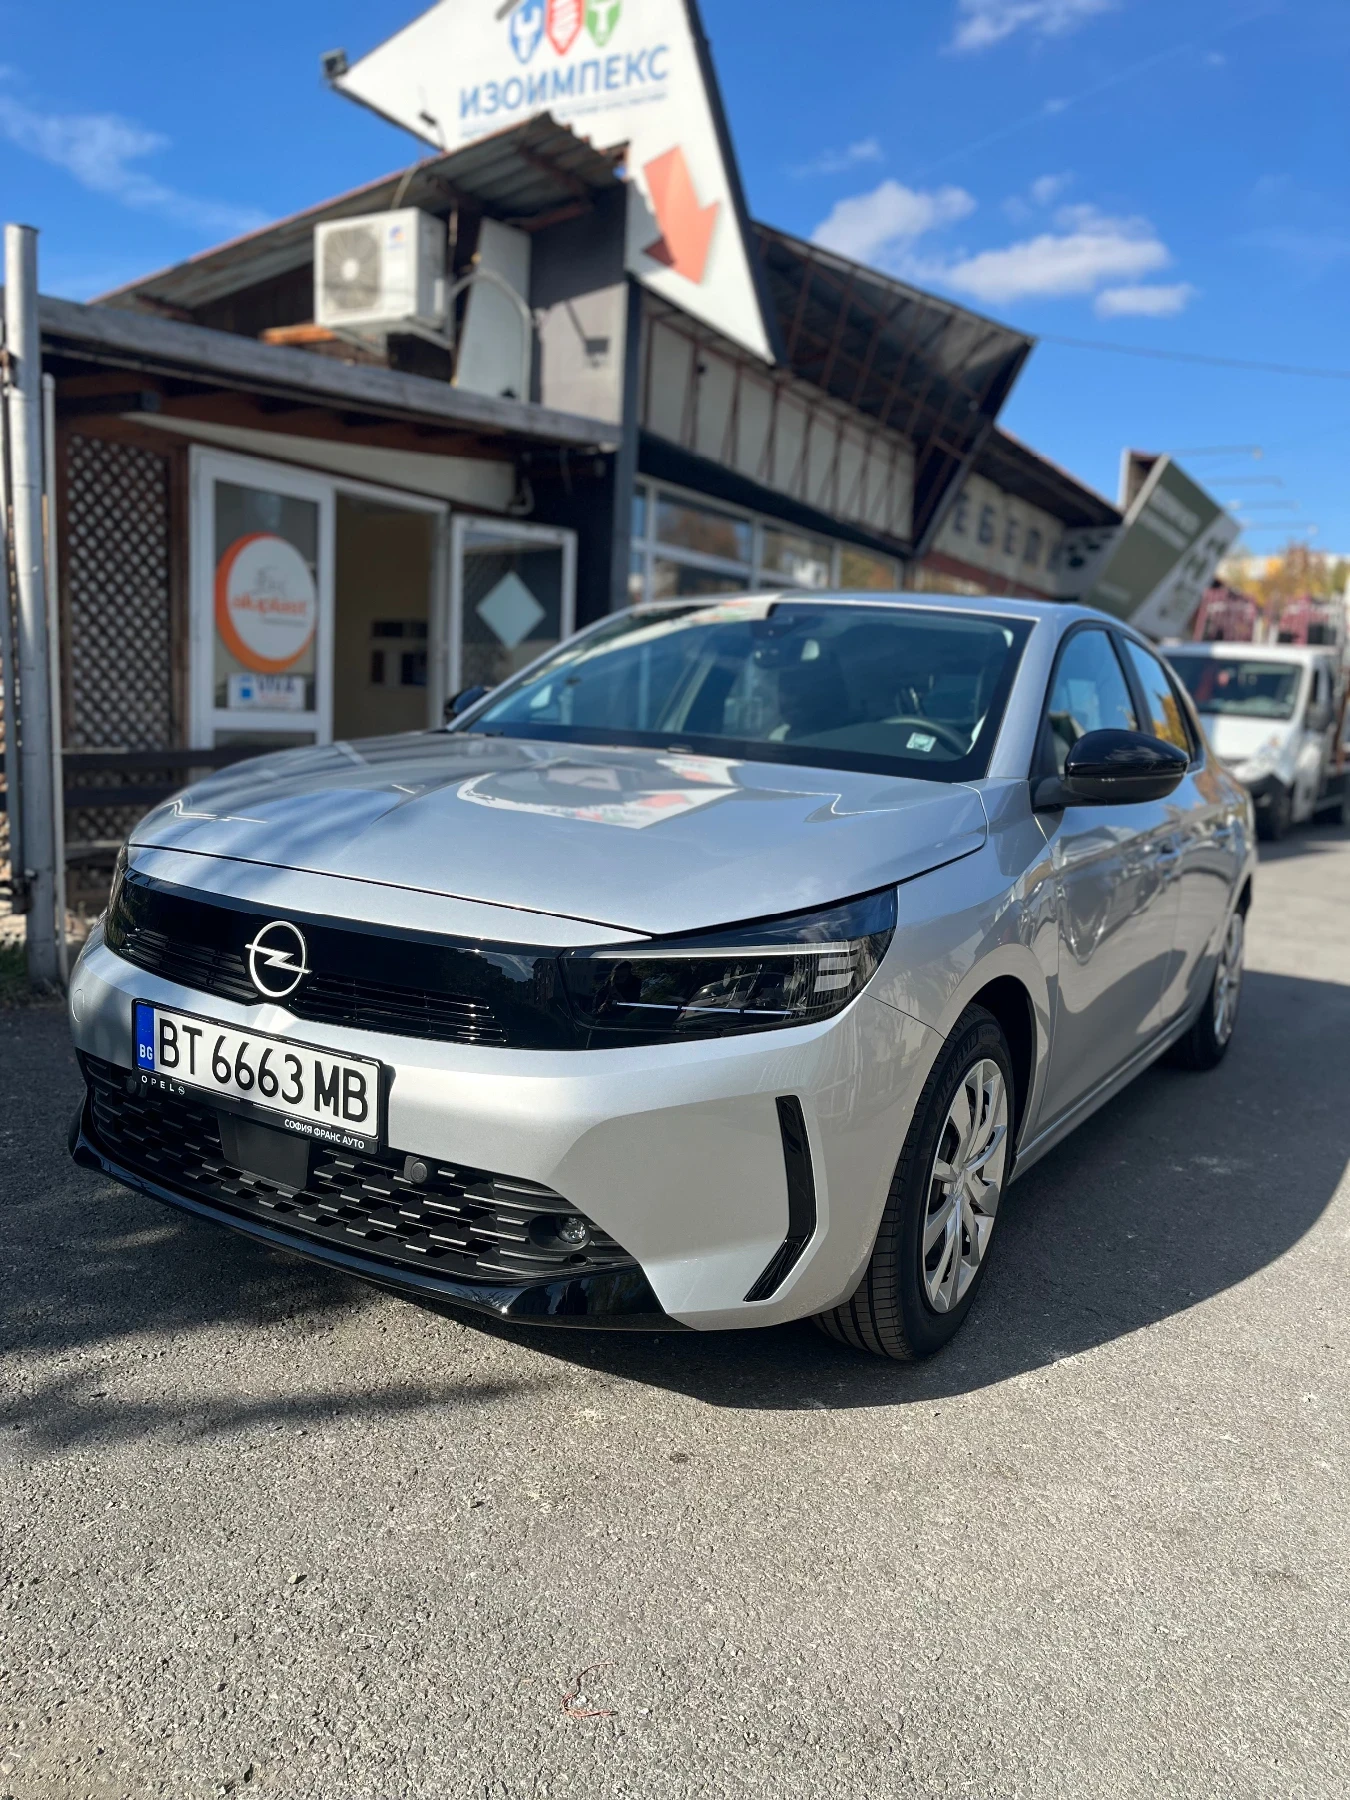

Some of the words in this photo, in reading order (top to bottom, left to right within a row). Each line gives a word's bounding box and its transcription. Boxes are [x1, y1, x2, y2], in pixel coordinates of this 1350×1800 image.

[459, 44, 670, 119] ИЗОИМПЕКС
[139, 1043, 153, 1061] BG
[141, 1075, 174, 1092] OPEL
[159, 1017, 203, 1076] BT
[211, 1034, 304, 1105] 6663
[314, 1060, 368, 1123] MB
[284, 1118, 313, 1134] СОФИЯ
[313, 1127, 341, 1142] ФРАНС
[342, 1135, 365, 1149] АУТО
